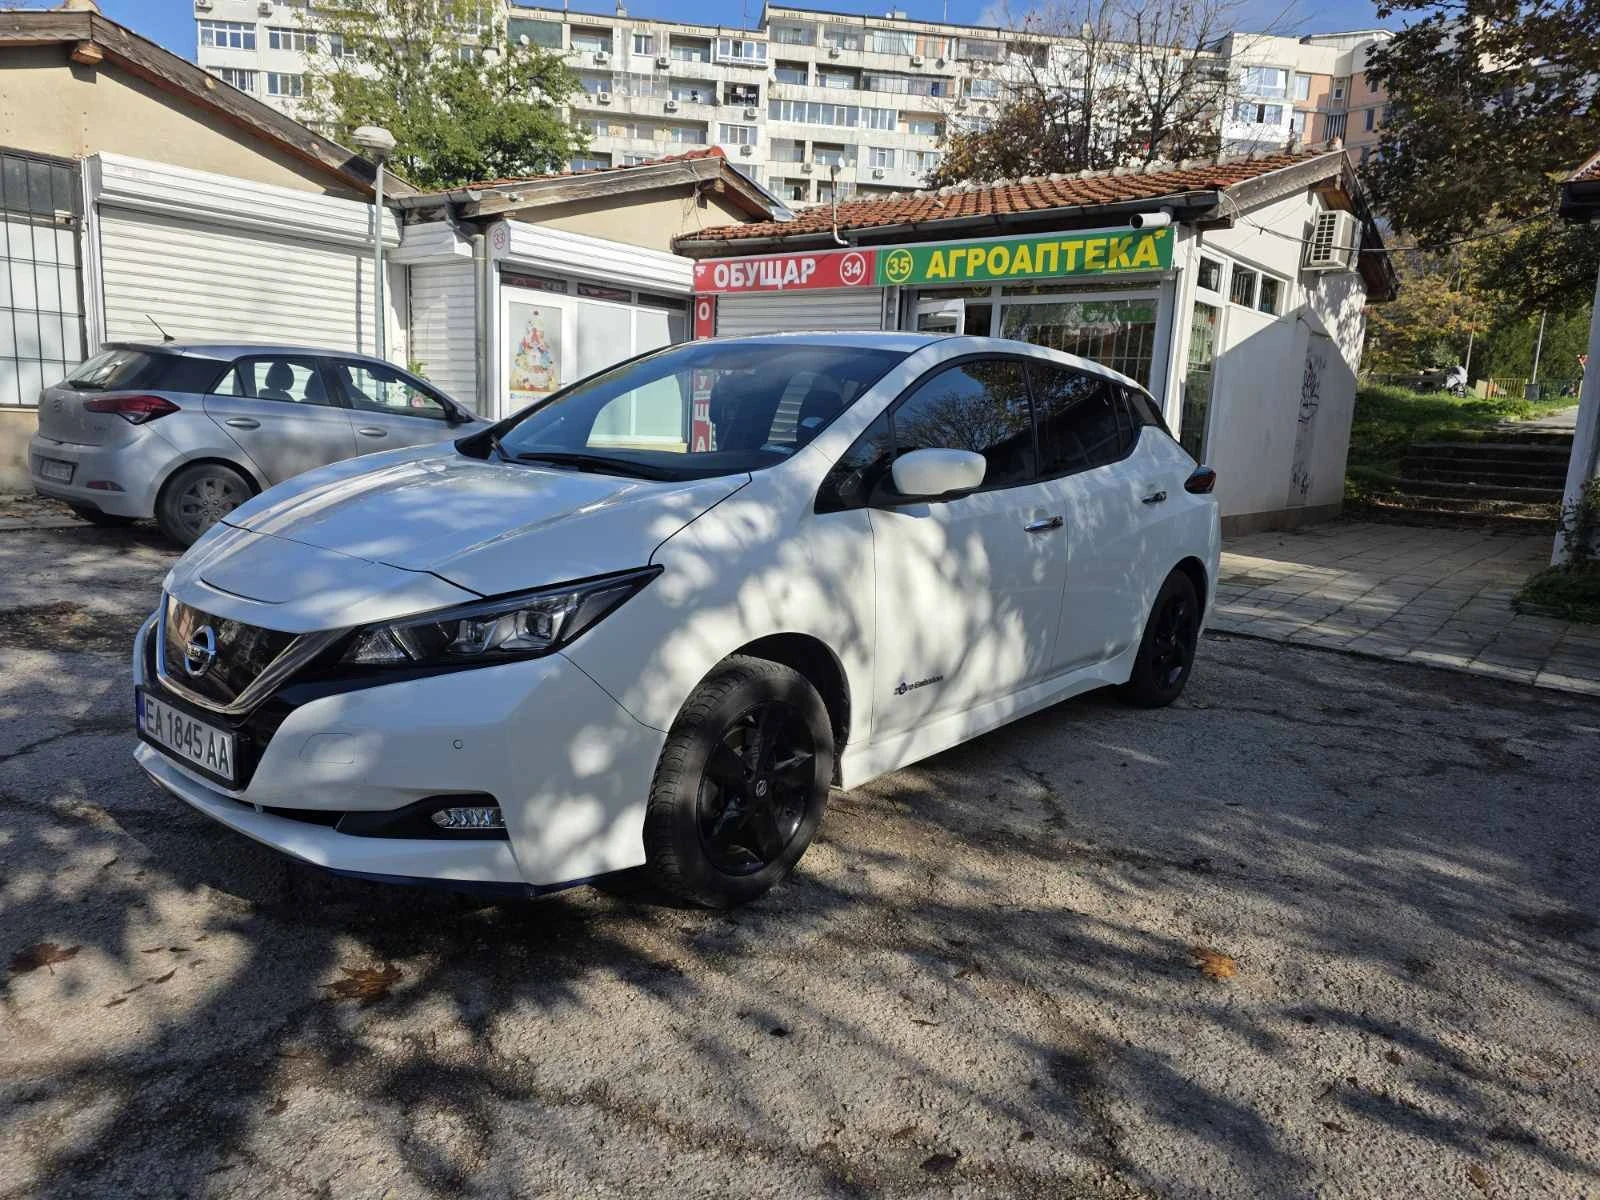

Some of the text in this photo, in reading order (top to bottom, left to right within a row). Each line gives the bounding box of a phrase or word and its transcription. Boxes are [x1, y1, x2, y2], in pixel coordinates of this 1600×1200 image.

[714, 257, 816, 290] ОБУЩАР
[844, 261, 862, 277] 34
[888, 258, 910, 276] 35
[925, 235, 1160, 280] АГРОАПТЕКА
[145, 699, 230, 775] EA 1845 AA
